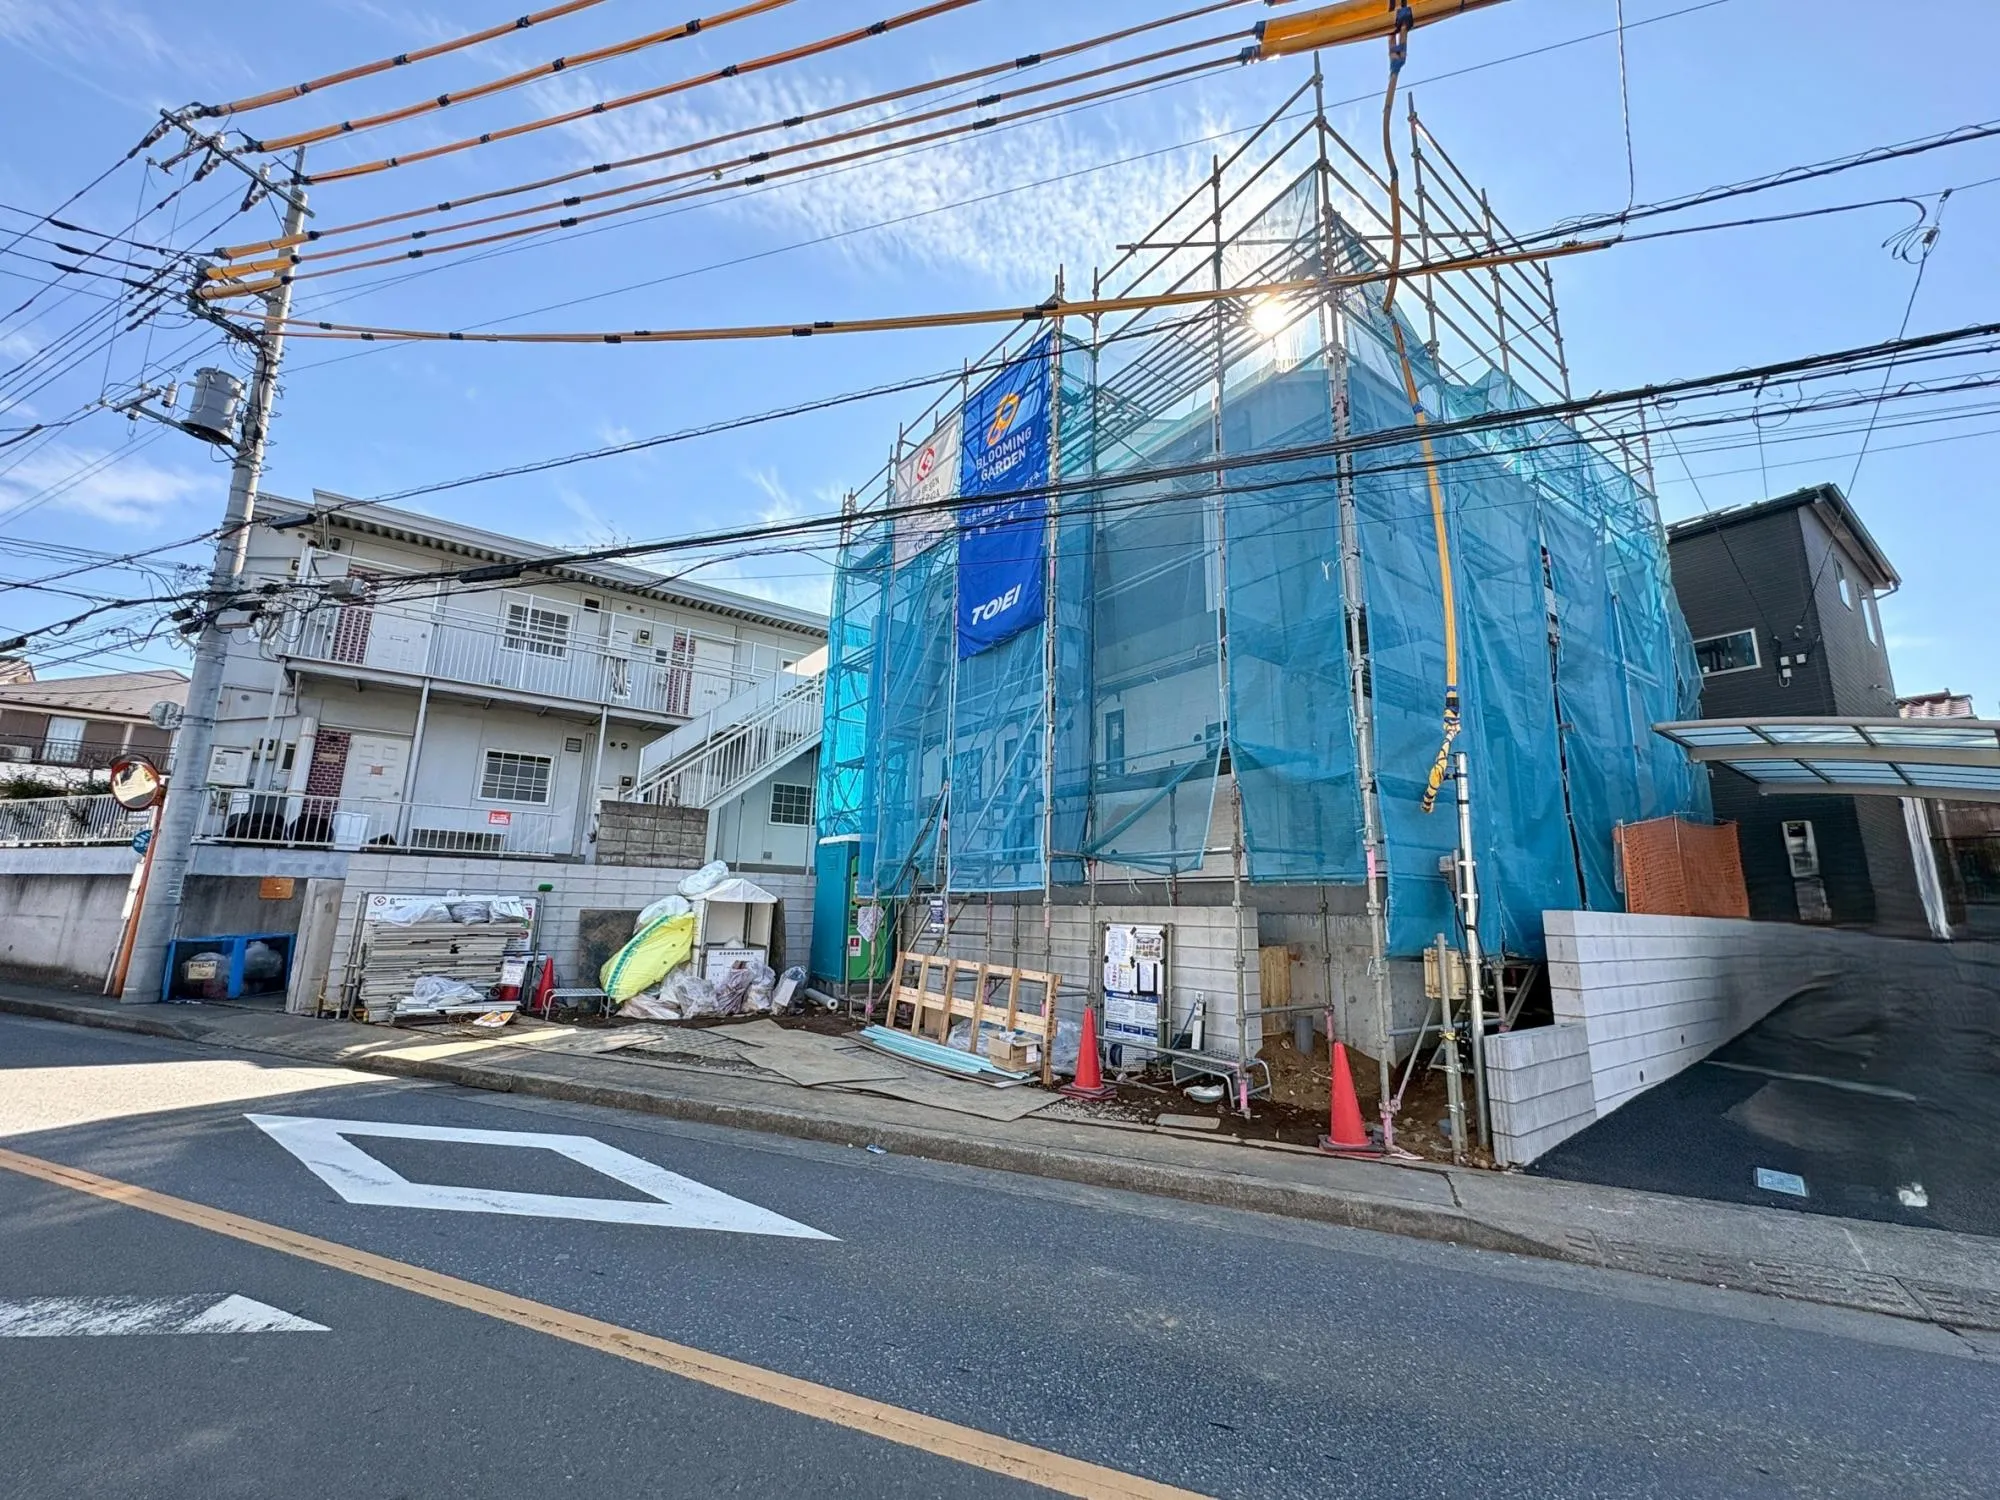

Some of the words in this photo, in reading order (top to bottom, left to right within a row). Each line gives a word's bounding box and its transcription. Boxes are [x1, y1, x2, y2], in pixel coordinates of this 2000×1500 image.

[976, 427, 1031, 470] BLOOMING
[981, 445, 1026, 482] GARDEN
[971, 584, 1021, 625] TOEI
